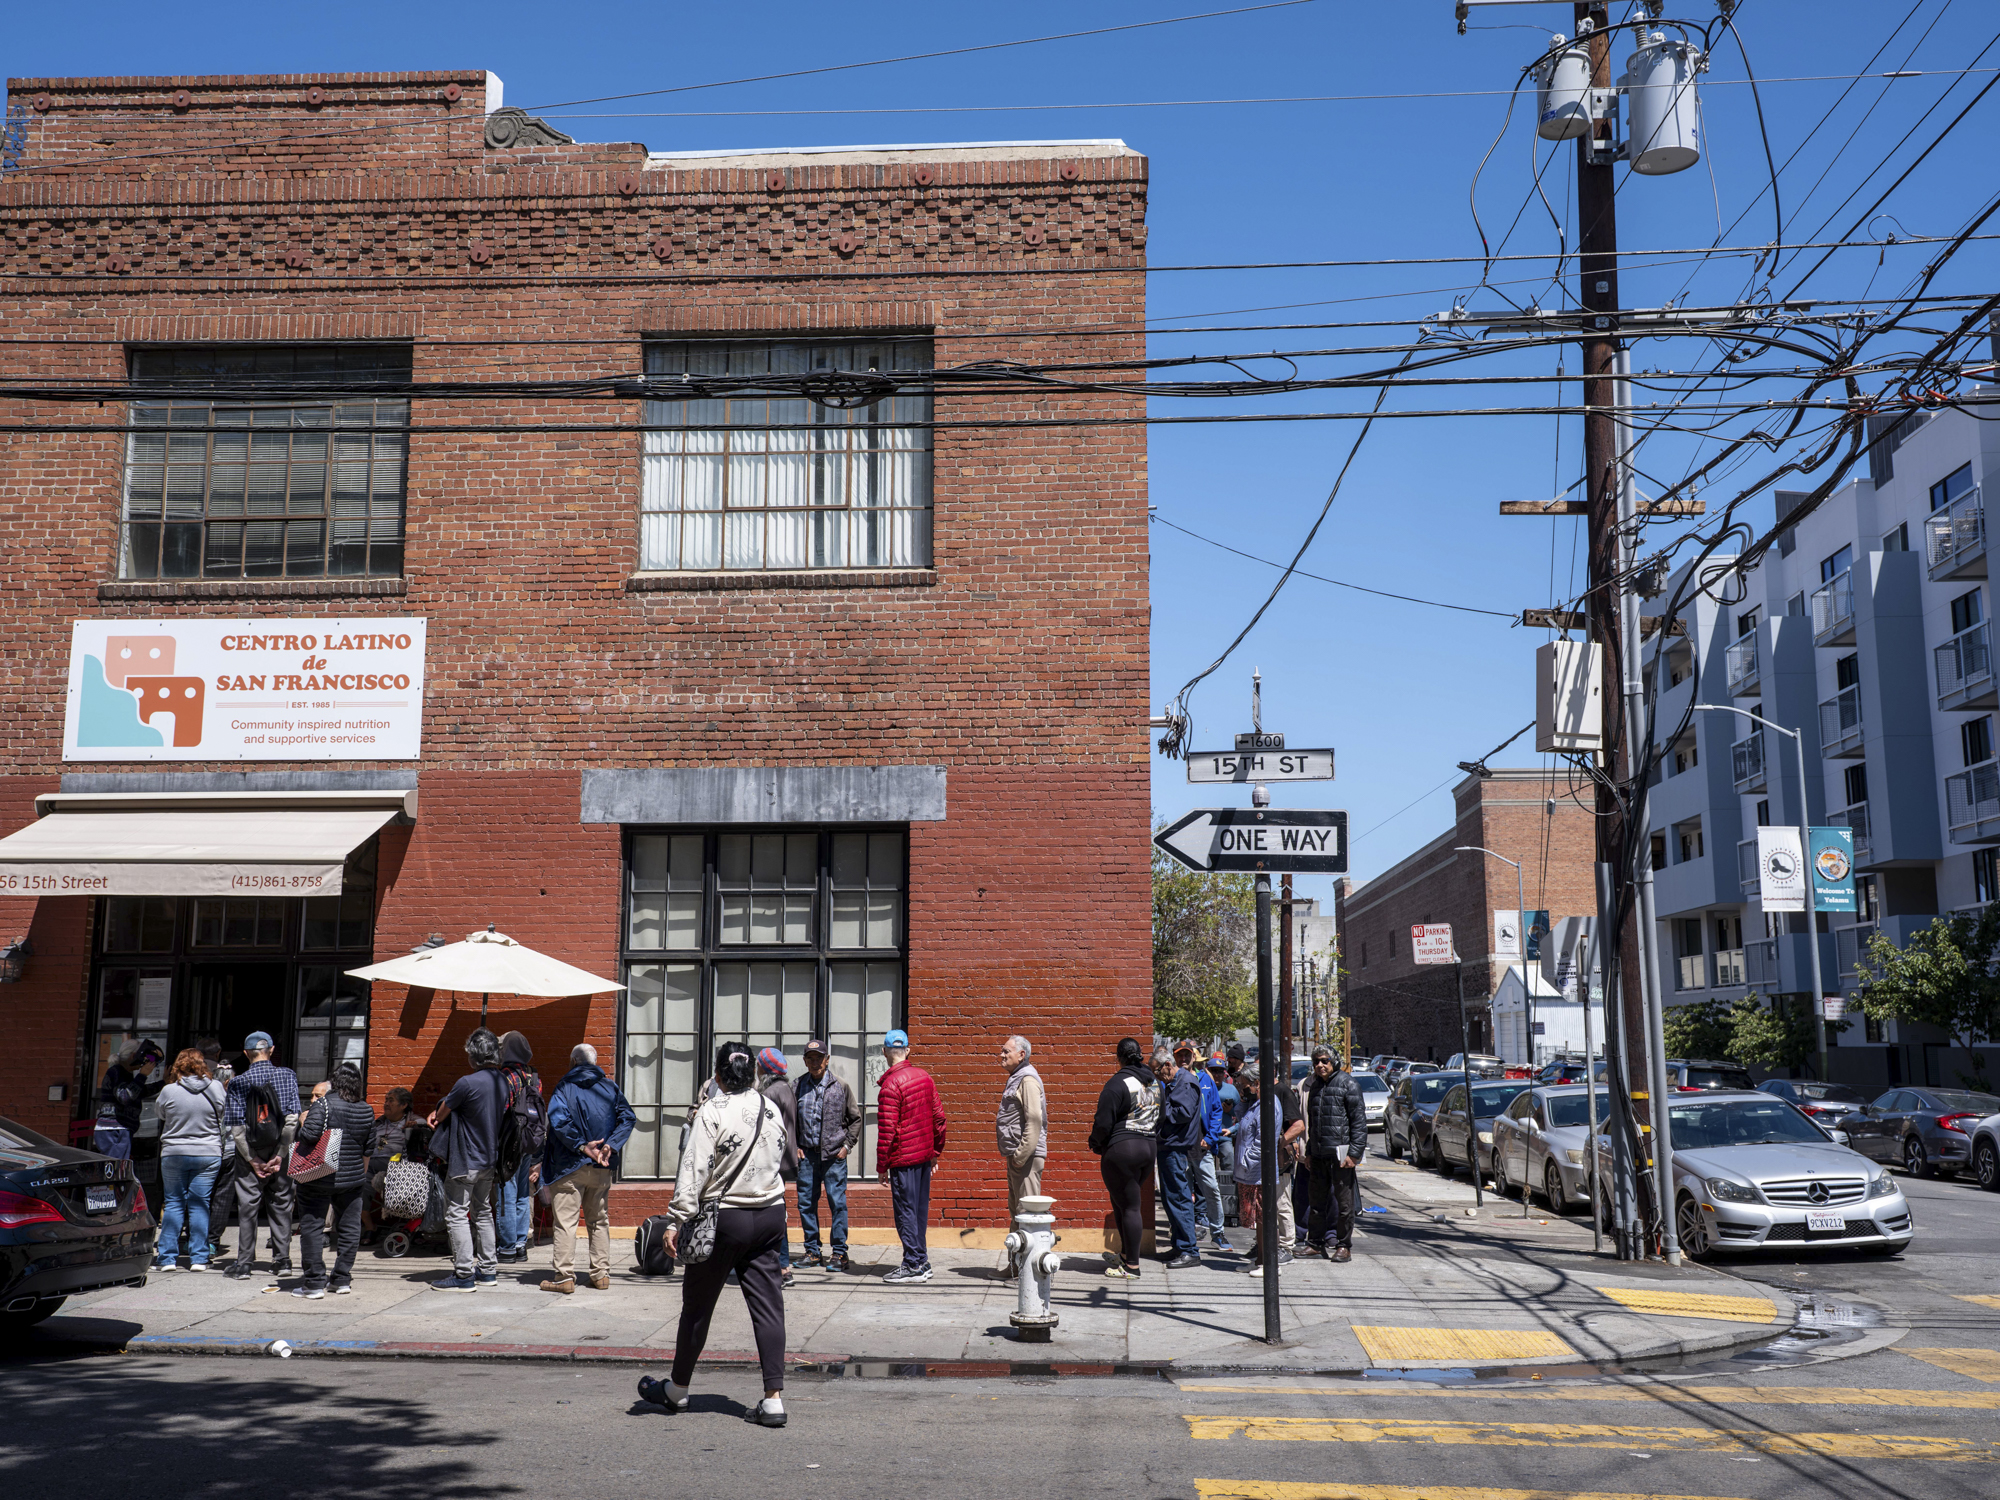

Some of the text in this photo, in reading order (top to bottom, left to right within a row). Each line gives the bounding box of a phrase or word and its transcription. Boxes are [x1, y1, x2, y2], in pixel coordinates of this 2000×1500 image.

[220, 634, 412, 651] CENTRO LATINO
[302, 655, 327, 670] de
[216, 674, 411, 691] SAN FRANCISCO
[291, 701, 331, 709] EST. 1985
[231, 719, 391, 732] Community inspired nutrition
[243, 733, 376, 746] and supportive services
[1251, 735, 1282, 748] 1600
[1212, 756, 1309, 775] 15TH ST
[1220, 829, 1332, 852] ONE WAY
[23, 875, 57, 889] 15th
[61, 875, 109, 889] Street
[231, 874, 323, 890] (415)861-8758
[1413, 926, 1449, 937] NO PARKING
[1435, 937, 1449, 946] 10AM
[1418, 948, 1448, 956] THURSDAY
[1810, 1218, 1843, 1228] 9CXV212
